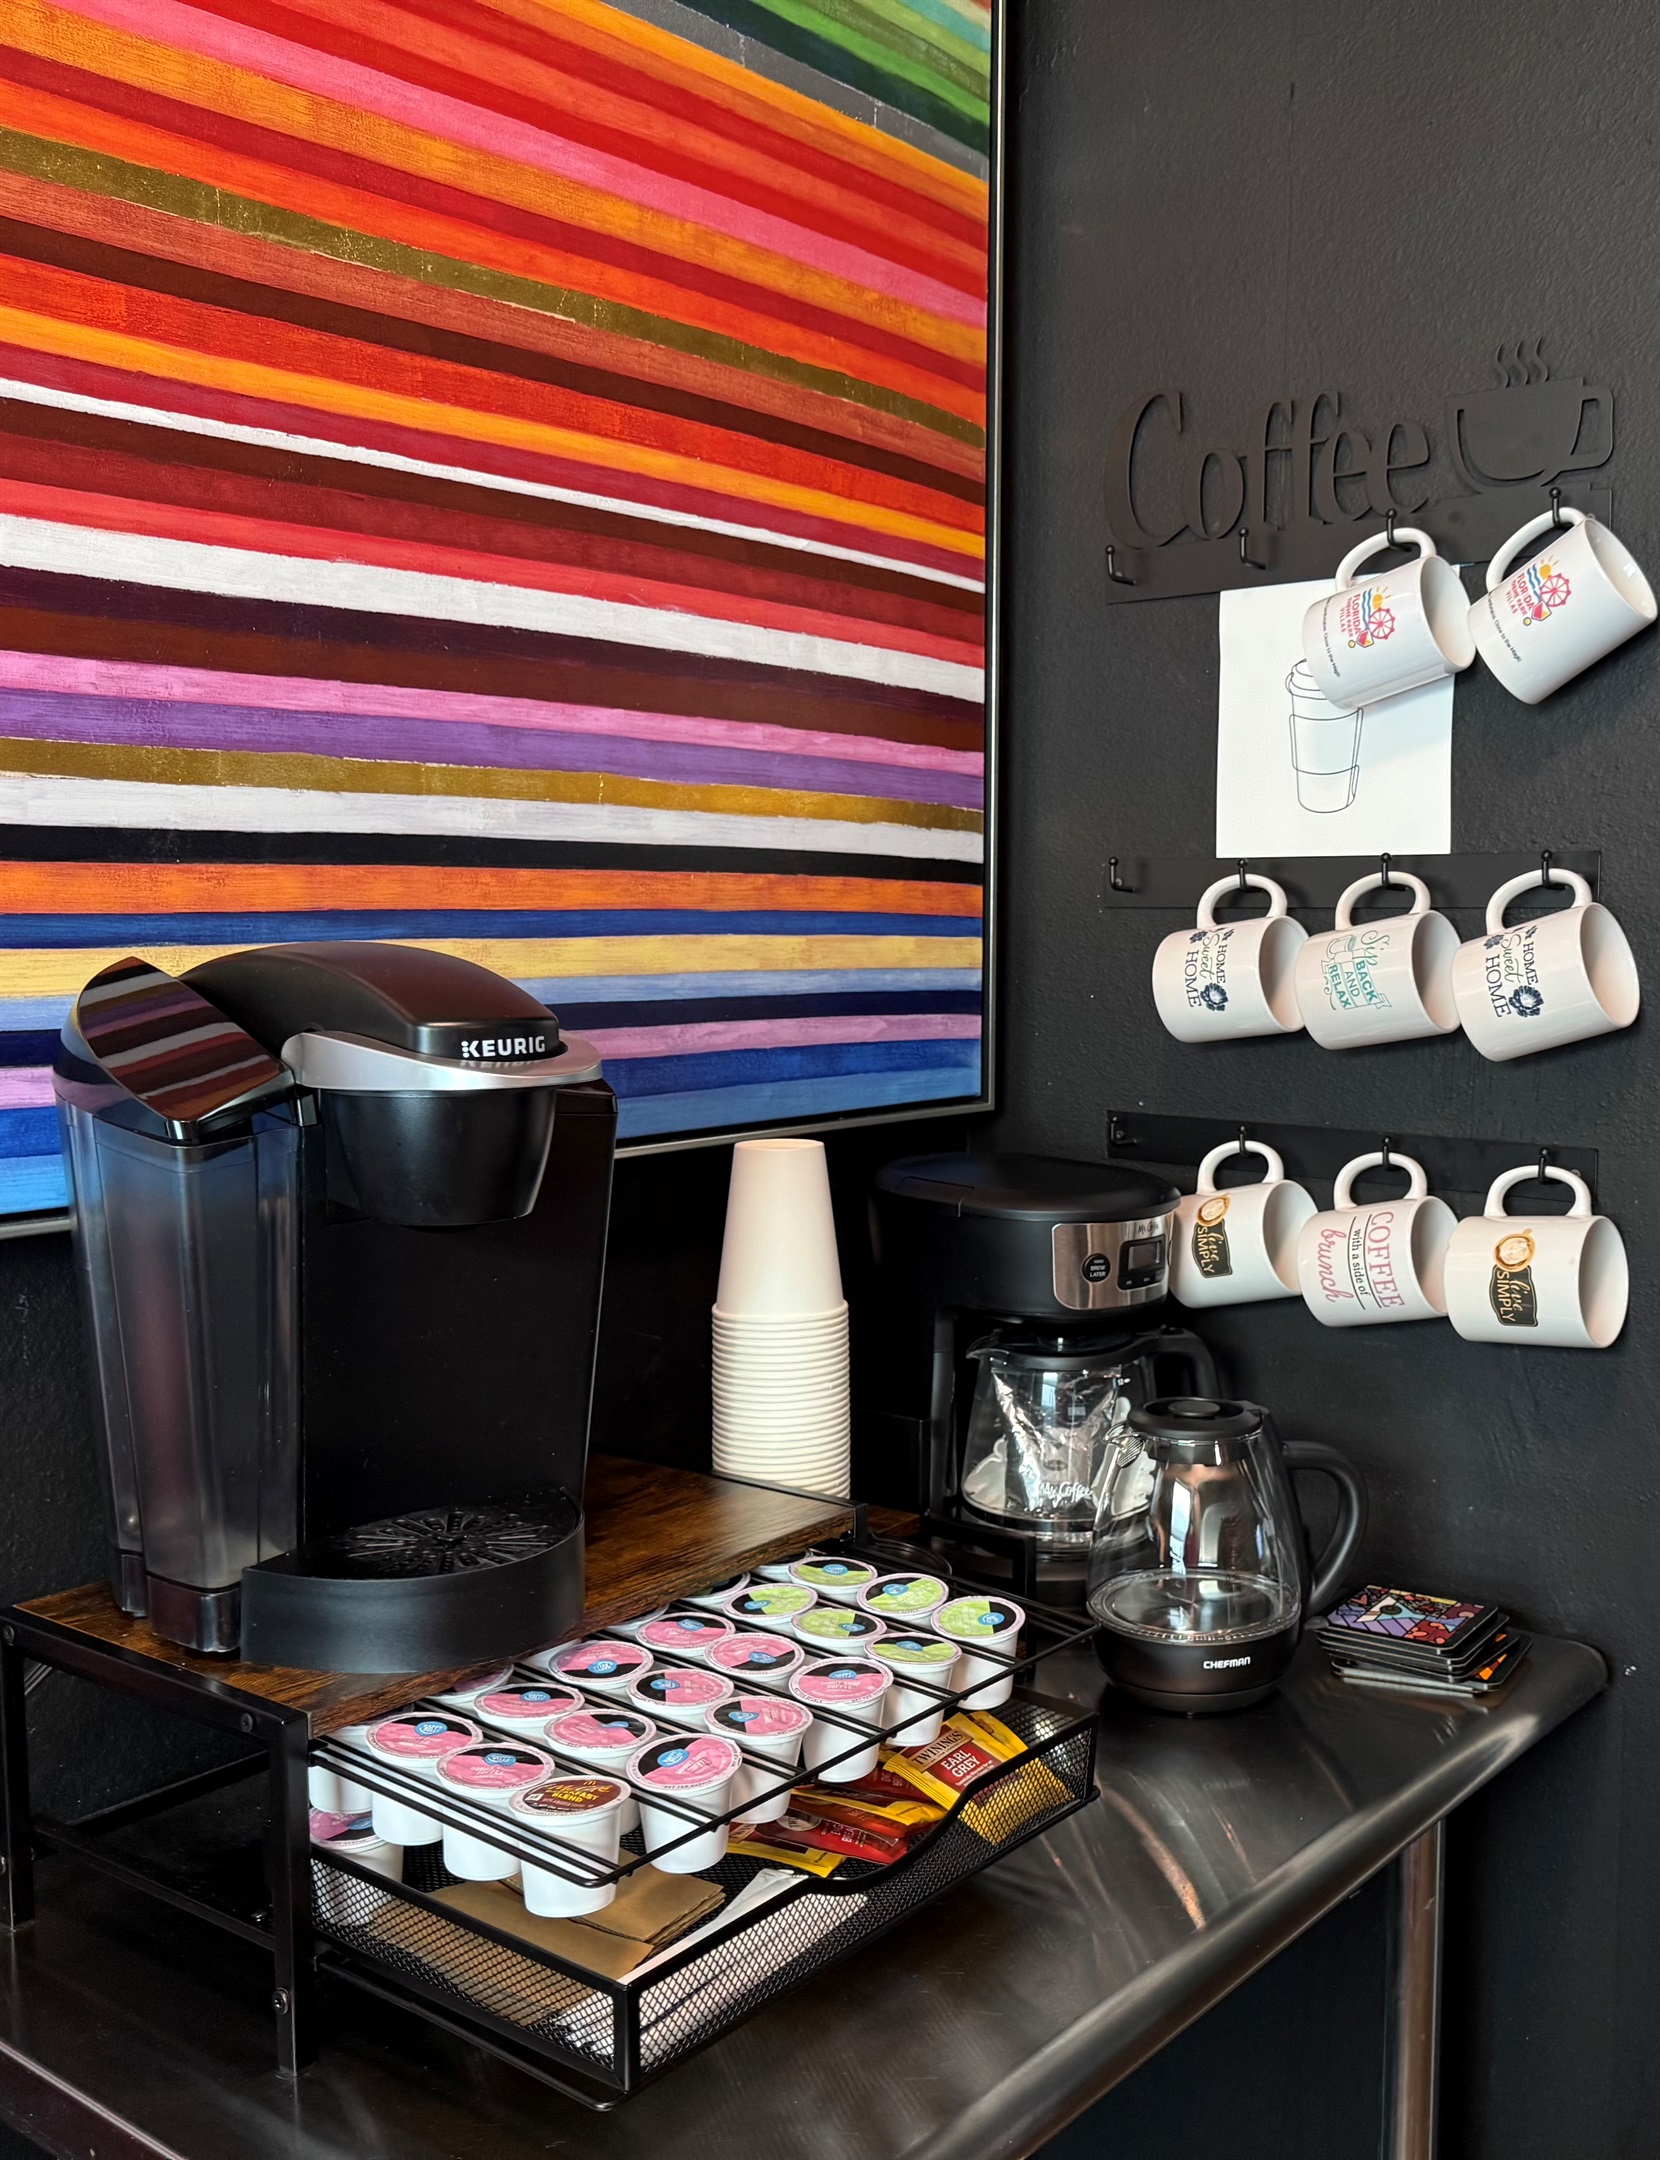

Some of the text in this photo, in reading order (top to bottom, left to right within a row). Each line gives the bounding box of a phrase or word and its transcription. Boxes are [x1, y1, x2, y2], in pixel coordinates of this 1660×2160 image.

[1104, 389, 1431, 549] Coffee
[1505, 590, 1519, 615] VILLAS
[1516, 573, 1533, 611] FLORIDA
[1516, 597, 1529, 617] PARK
[1351, 593, 1362, 635] FLORIDA
[1199, 933, 1220, 981] Sweet
[1216, 944, 1228, 983] HOME
[1352, 929, 1391, 966] Sip
[1500, 933, 1524, 983] Sweet
[1522, 941, 1539, 986] HOME
[1184, 949, 1202, 1008] HOME
[1329, 964, 1352, 1009] RELAX
[1344, 971, 1361, 997] AND
[1355, 959, 1378, 1003] BACK
[1485, 953, 1512, 1018] HOME
[461, 1036, 546, 1058] KEURIG
[1197, 1226, 1215, 1273] SIMPLY
[1208, 1232, 1224, 1261] live
[1351, 1228, 1363, 1252] with
[1317, 1228, 1354, 1303] brunch
[1352, 1262, 1365, 1284] side
[1367, 1211, 1405, 1308] COFFEE
[1358, 1286, 1371, 1296] of
[1496, 1270, 1516, 1323] SIMPLY
[1509, 1278, 1530, 1312] live
[1058, 1481, 1093, 1503] Coffee
[1203, 1656, 1251, 1669] CHEFMAN
[912, 1730, 965, 1766] TWININGS
[940, 1749, 972, 1771] EARL
[951, 1755, 982, 1778] GREY
[551, 1792, 583, 1803] BLEND
